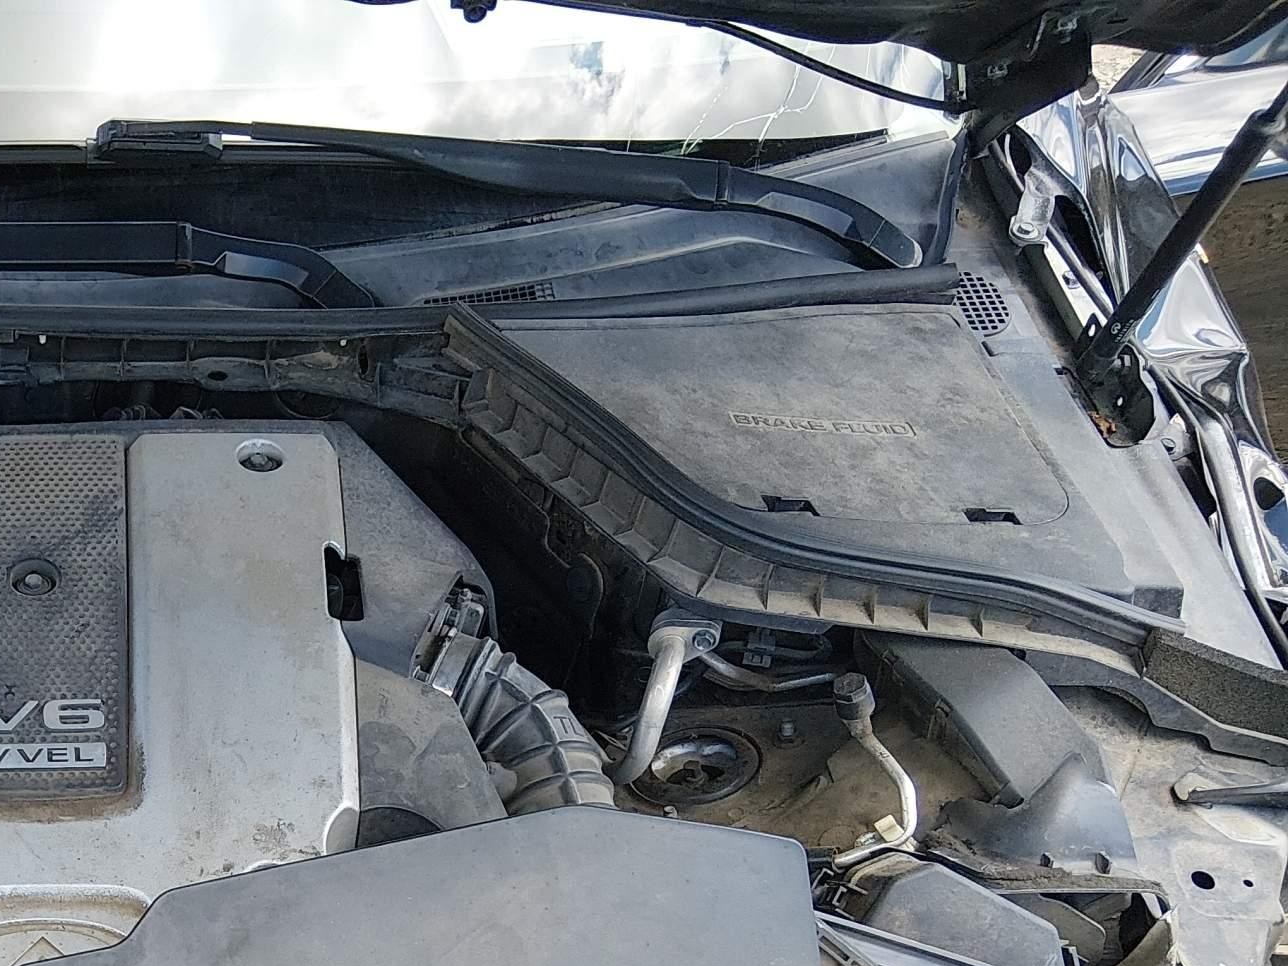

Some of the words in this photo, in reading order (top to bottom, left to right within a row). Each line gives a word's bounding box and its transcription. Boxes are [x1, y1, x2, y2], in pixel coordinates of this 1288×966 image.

[732, 413, 827, 432] BRAKE
[831, 421, 909, 436] FLUID
[553, 715, 585, 738] TL
